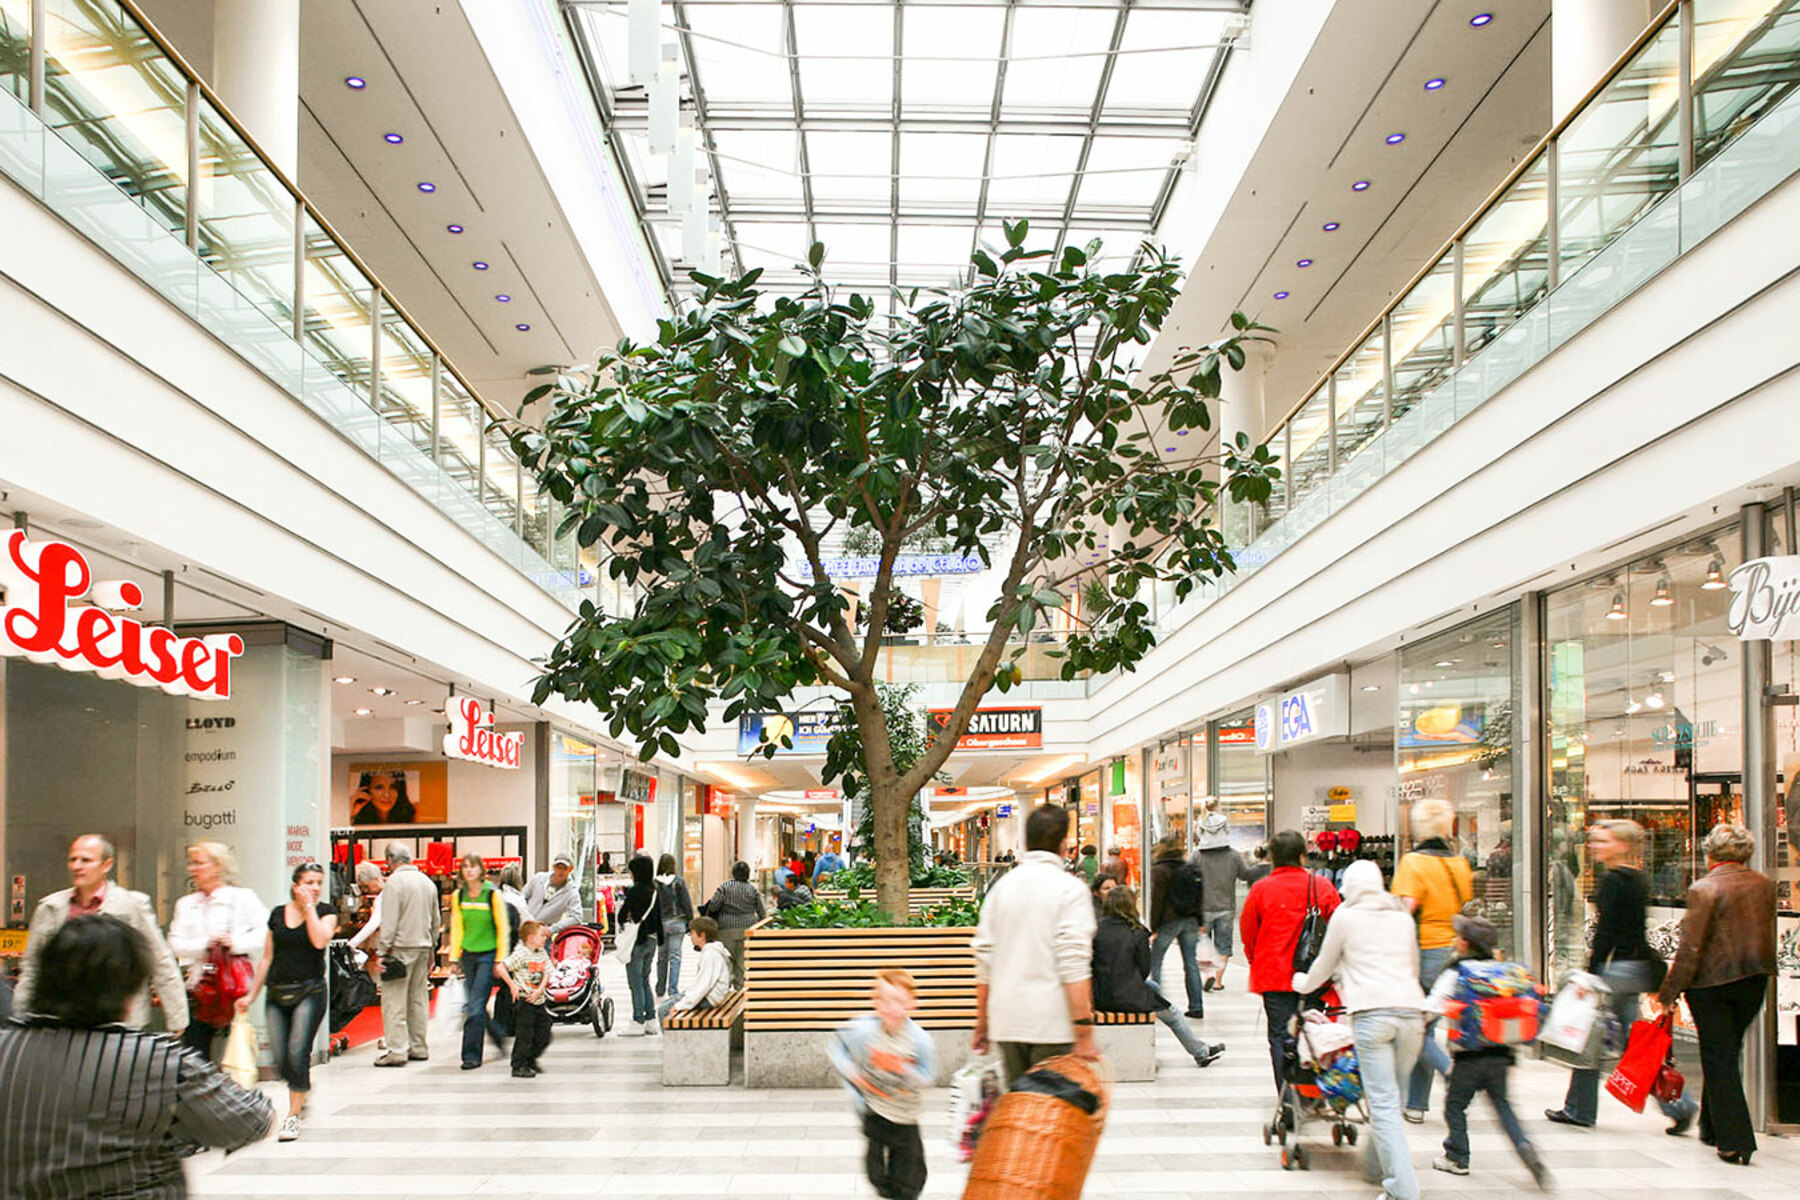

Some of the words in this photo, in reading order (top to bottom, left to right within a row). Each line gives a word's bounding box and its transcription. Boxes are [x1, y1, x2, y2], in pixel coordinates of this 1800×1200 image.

[4, 531, 244, 697] Leiser
[185, 717, 236, 729] LLOYD
[459, 698, 524, 766] Leiser
[968, 713, 1034, 733] SATURN
[184, 810, 236, 829] bugatti
